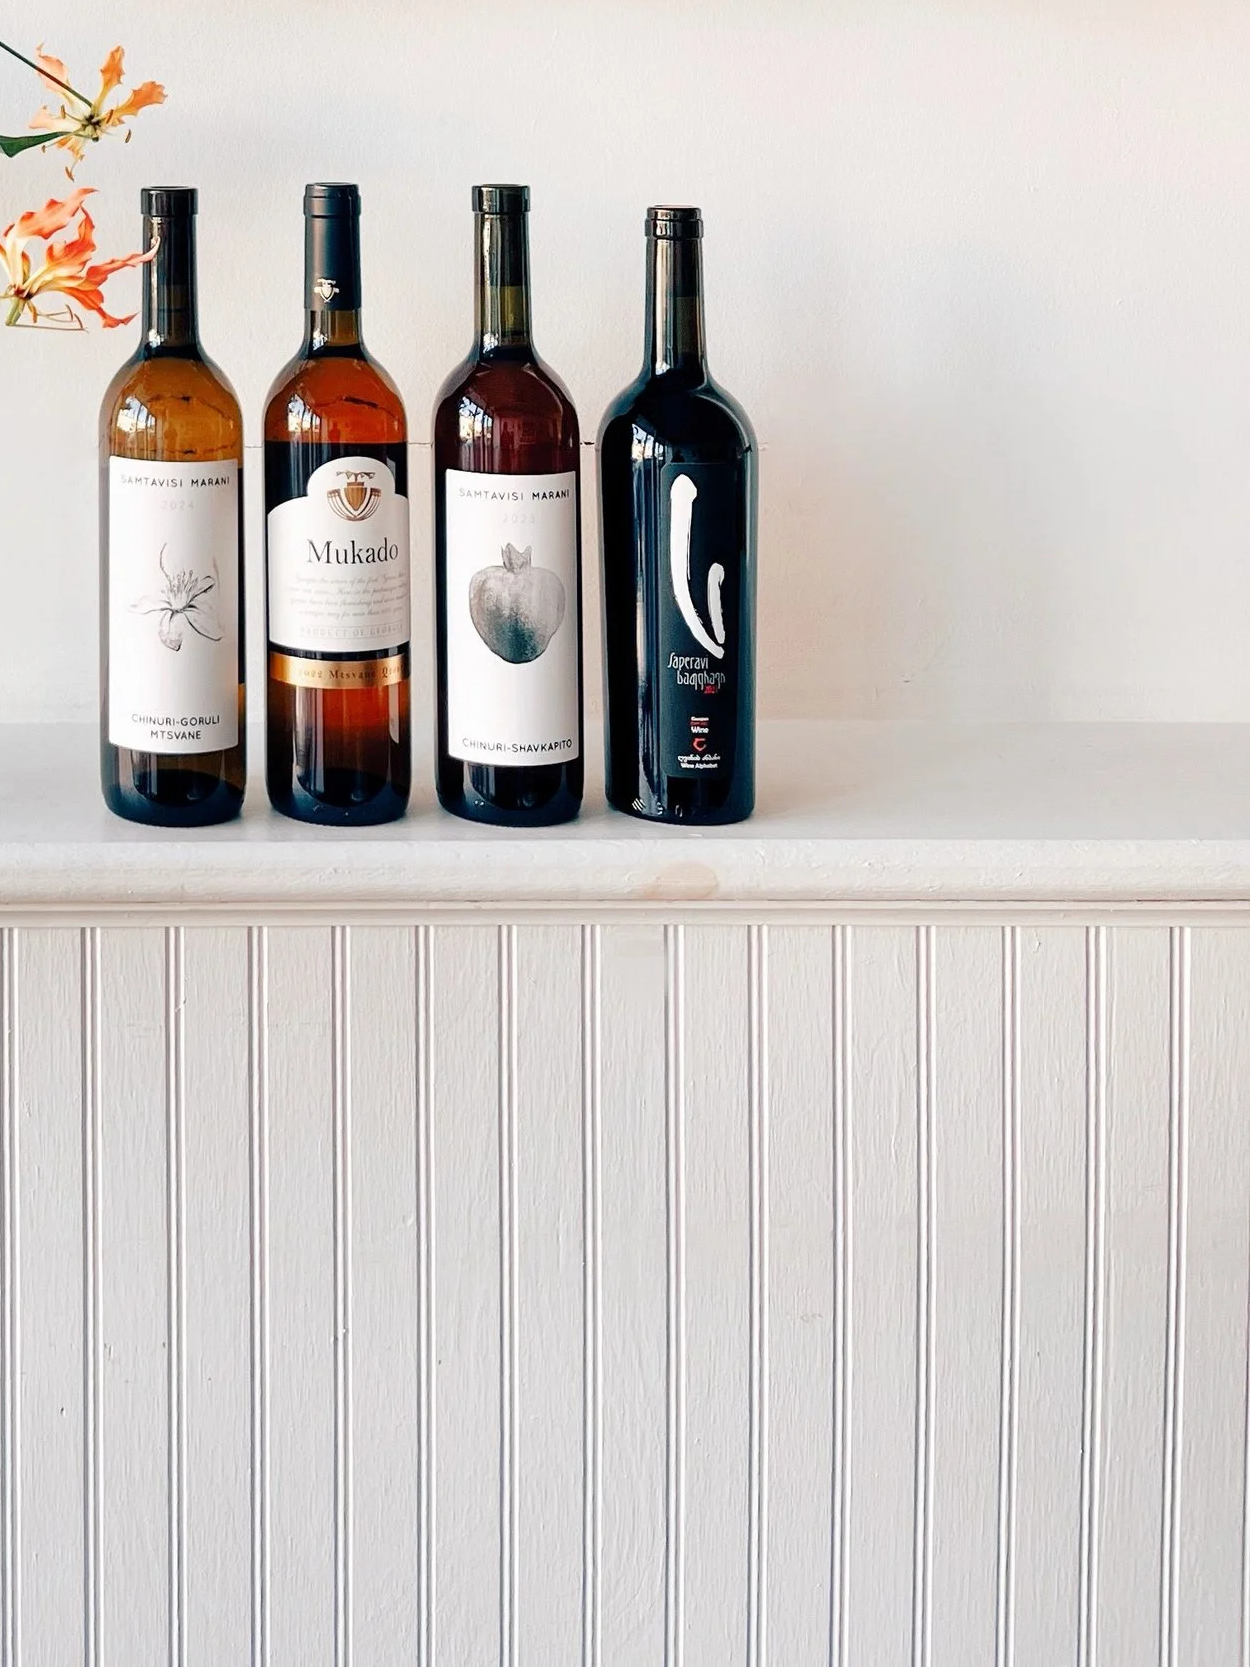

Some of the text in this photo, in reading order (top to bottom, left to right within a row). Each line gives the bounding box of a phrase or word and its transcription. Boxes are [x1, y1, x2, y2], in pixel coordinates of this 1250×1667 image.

[120, 475, 230, 488] SAMTAVISI MARANI
[459, 488, 570, 501] SAMTAVISI MARANI
[306, 537, 399, 564] Mukado
[131, 714, 220, 727] CHINURI-GORULI
[150, 730, 202, 740] MTSVANE
[462, 738, 573, 753] CHINURI-SHAVKAPITO
